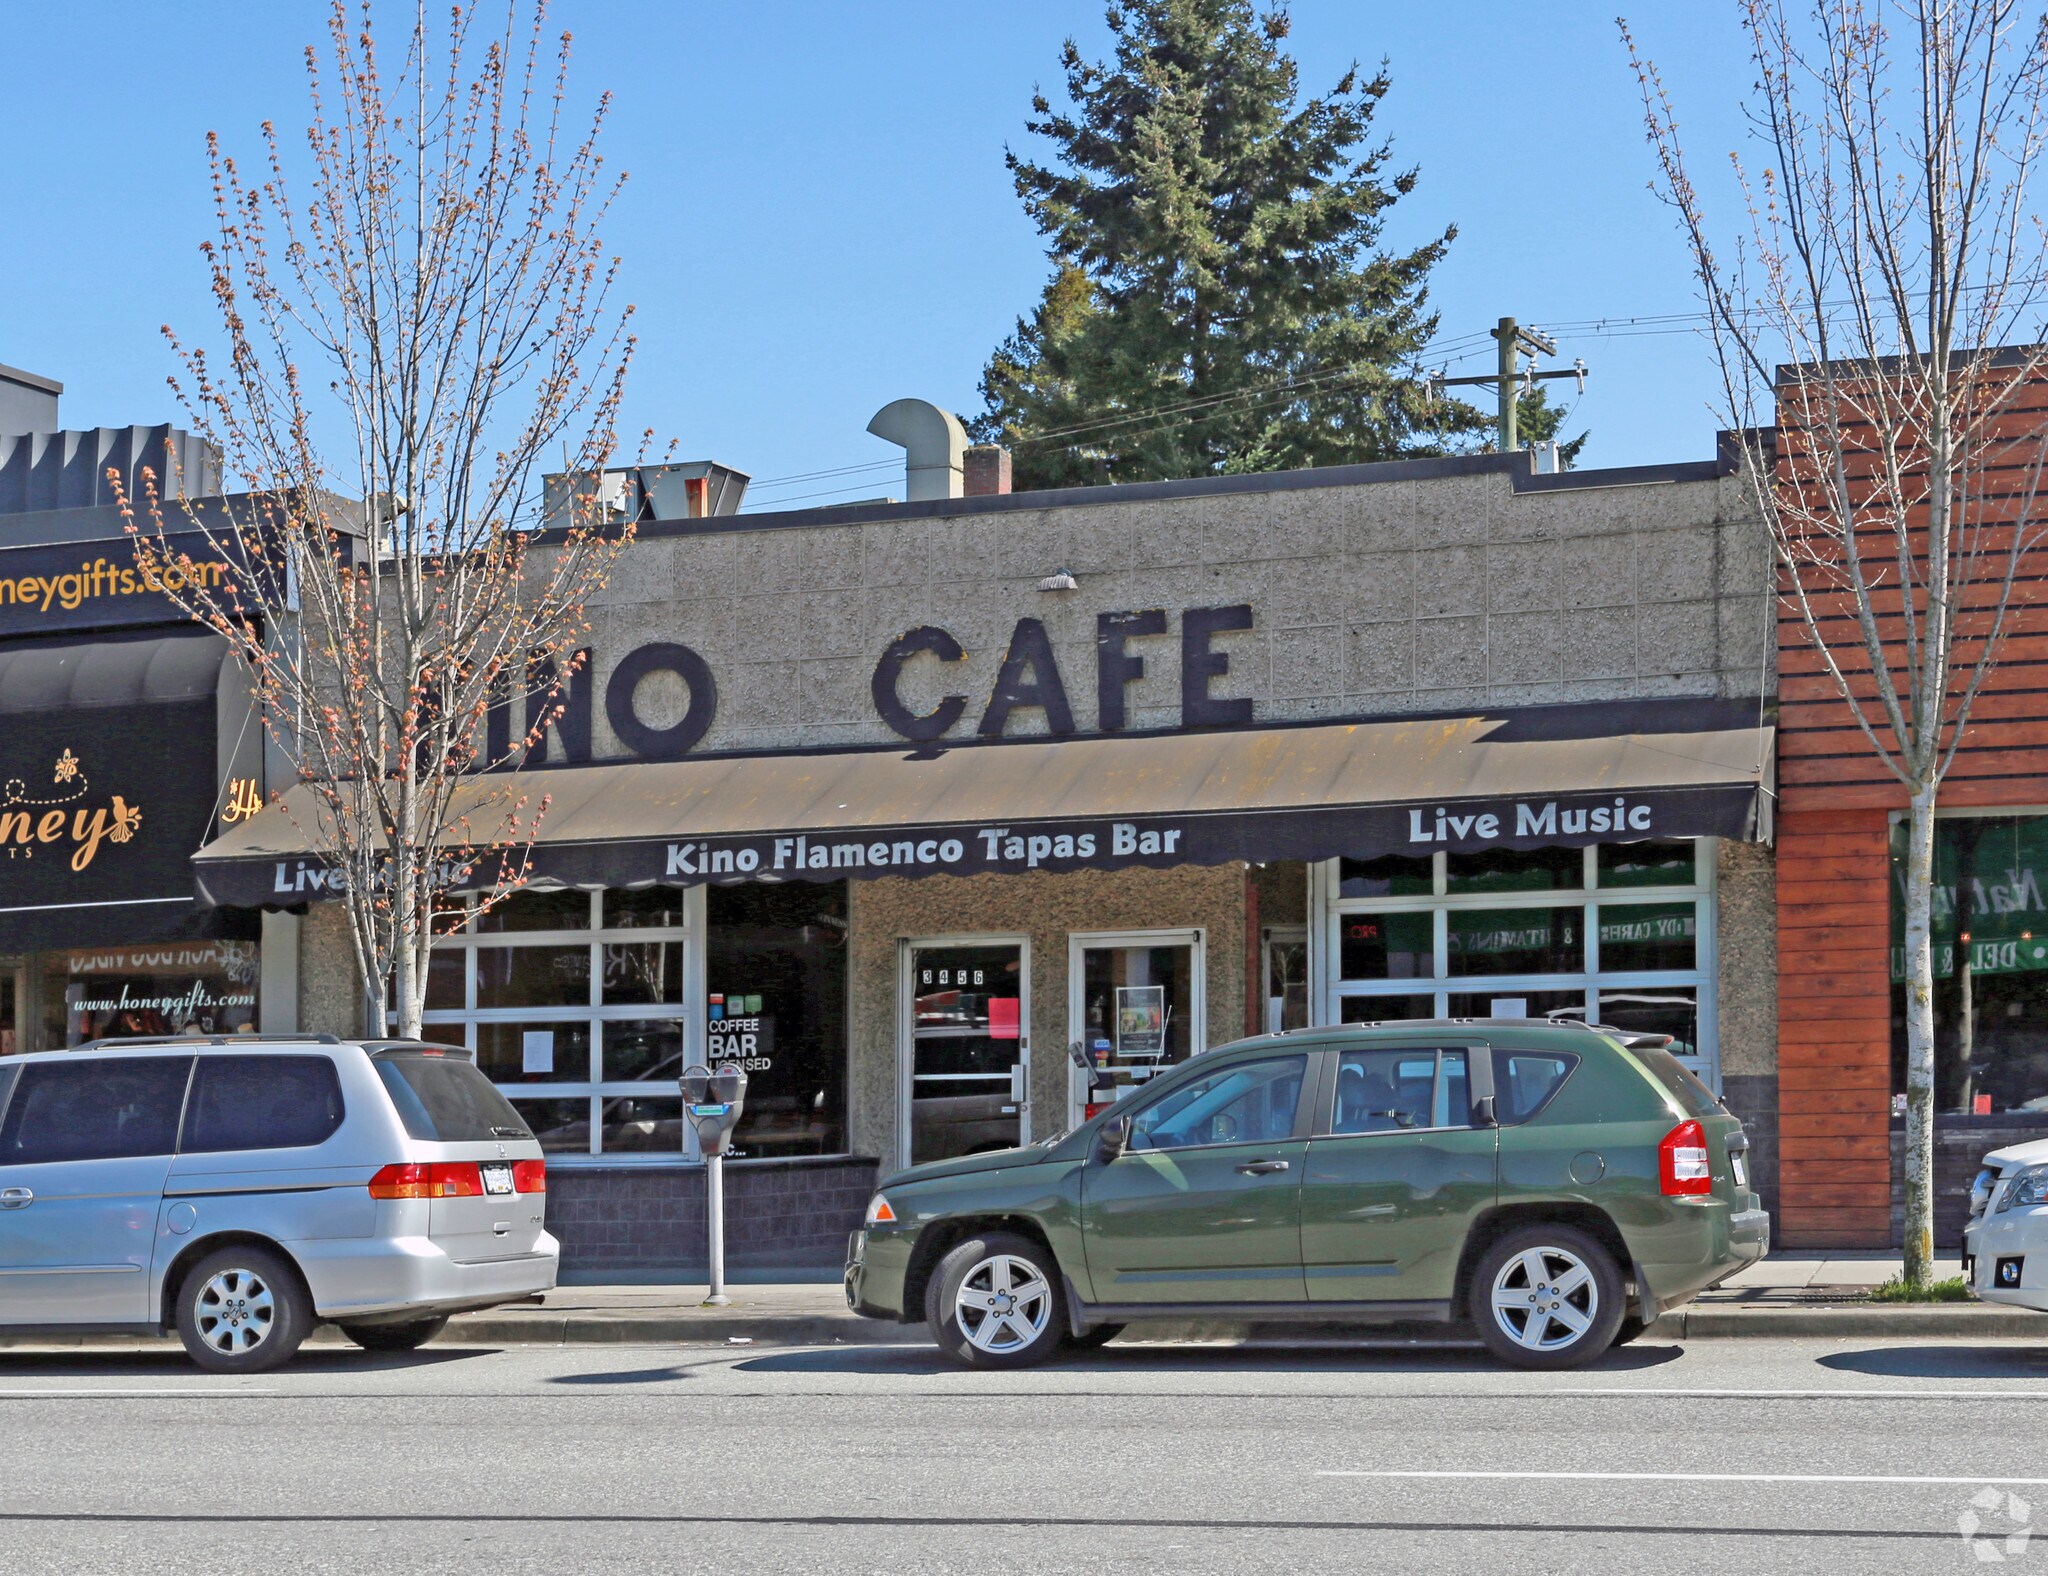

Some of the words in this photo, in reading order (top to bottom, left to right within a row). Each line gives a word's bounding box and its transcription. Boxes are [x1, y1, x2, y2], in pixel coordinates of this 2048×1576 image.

[872, 605, 1253, 741] CAFE
[1409, 807, 1499, 842] Live
[1515, 797, 1651, 836] Music
[666, 843, 759, 875] Kino
[773, 837, 964, 869] Flamenco
[977, 828, 1096, 867] Tapas
[1112, 823, 1181, 856] Bar
[274, 861, 347, 892] Live
[74, 980, 255, 1017] www.honeygifts.com
[709, 1018, 759, 1033] COFFEE
[709, 1034, 757, 1059] BAR
